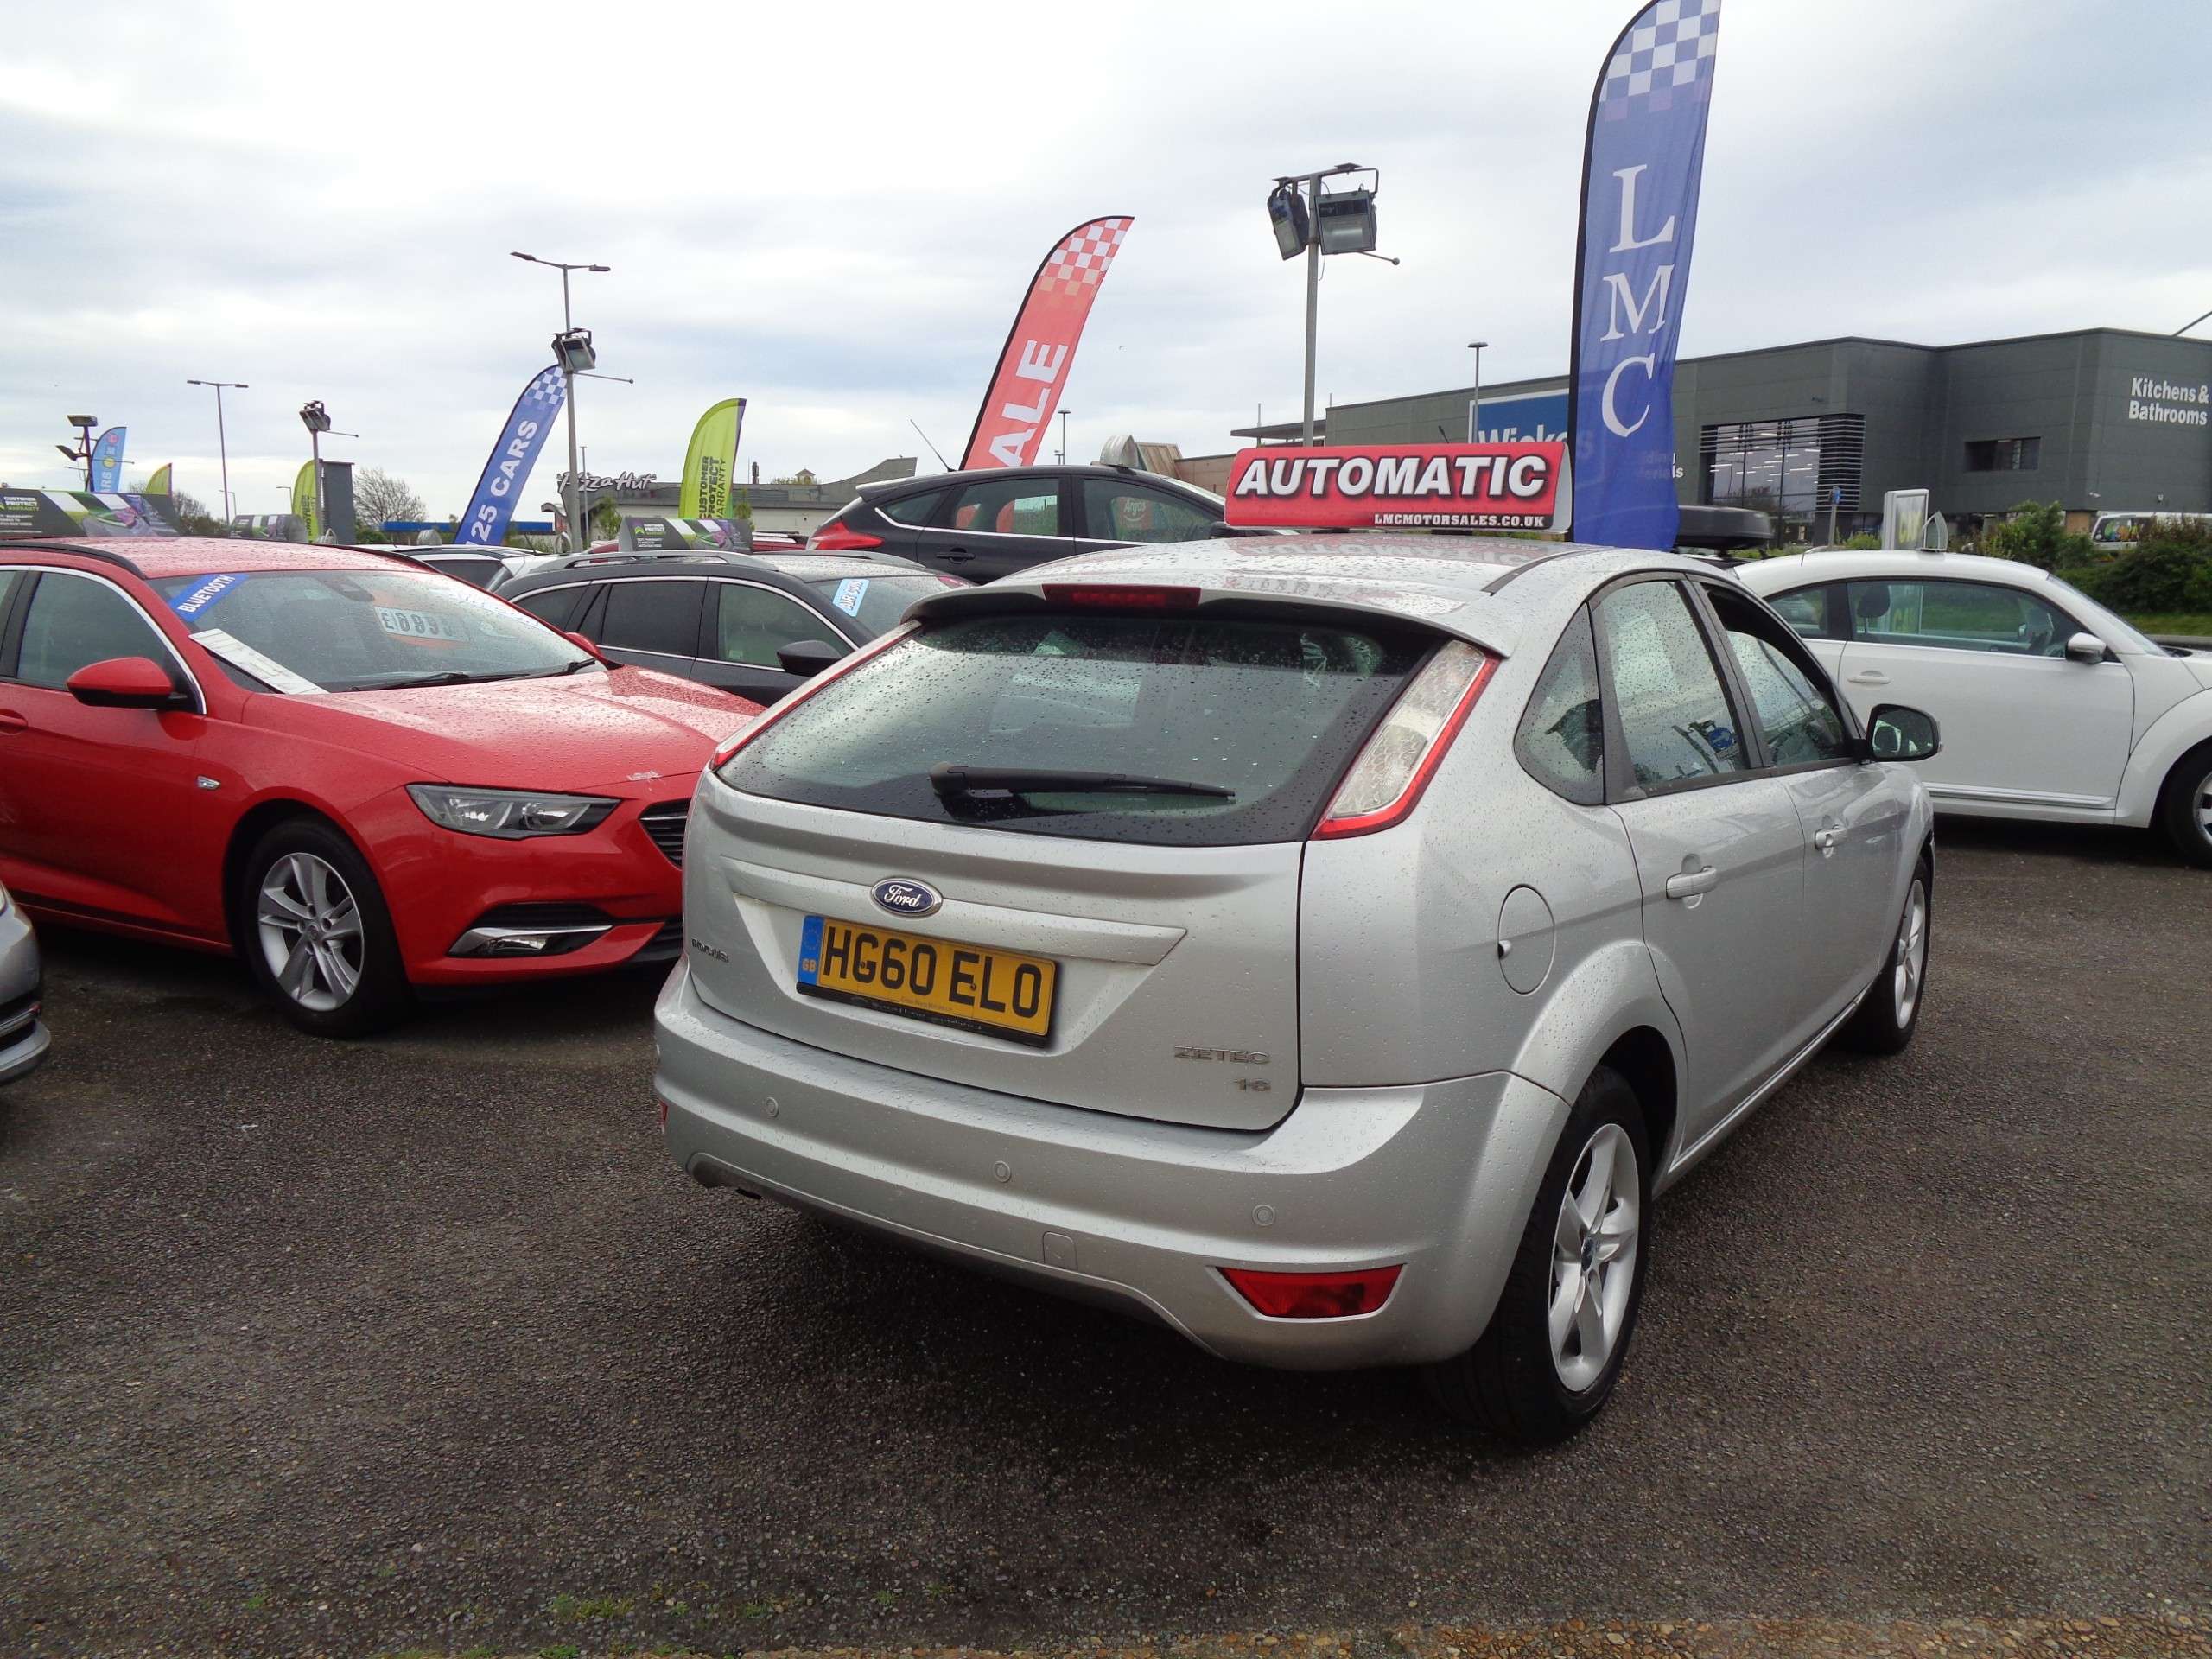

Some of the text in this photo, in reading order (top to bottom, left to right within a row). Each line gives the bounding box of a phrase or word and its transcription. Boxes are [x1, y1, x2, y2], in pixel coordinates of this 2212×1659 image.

[2131, 378, 2209, 404] Kitchens &
[2128, 400, 2208, 425] Bathrooms
[490, 420, 538, 497] CARS
[614, 471, 657, 491] Hut
[1234, 454, 1547, 498] AUTOMATIC
[1374, 513, 1546, 528] LMCMOTORSALES.CO.UK
[177, 575, 236, 613] BLUETOOTH
[883, 884, 923, 908] Ford
[801, 957, 817, 974] GB
[823, 925, 938, 997] HG60
[948, 950, 1043, 1019] ELO
[1174, 1046, 1271, 1065] ZETEC
